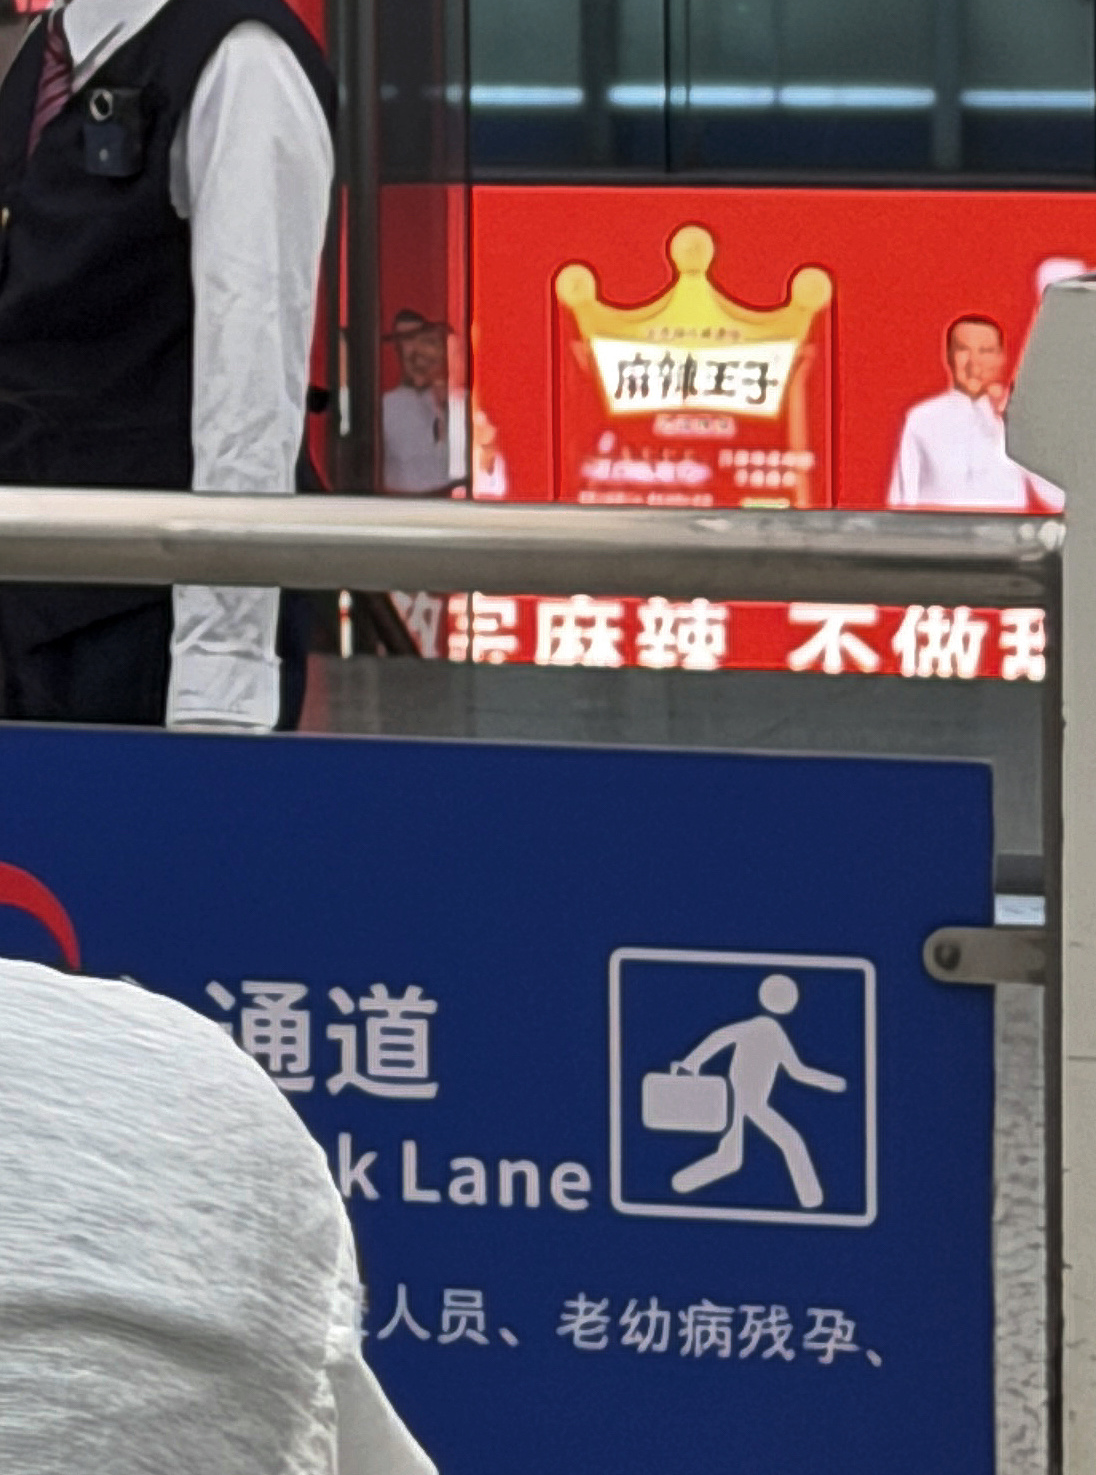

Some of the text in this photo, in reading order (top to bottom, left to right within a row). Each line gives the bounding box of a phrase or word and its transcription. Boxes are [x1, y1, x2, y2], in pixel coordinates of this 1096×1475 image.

[614, 350, 779, 405] 麻辣王子
[402, 1139, 592, 1211] Lane
[358, 1283, 884, 1368] 人员、老幼病残孕、
